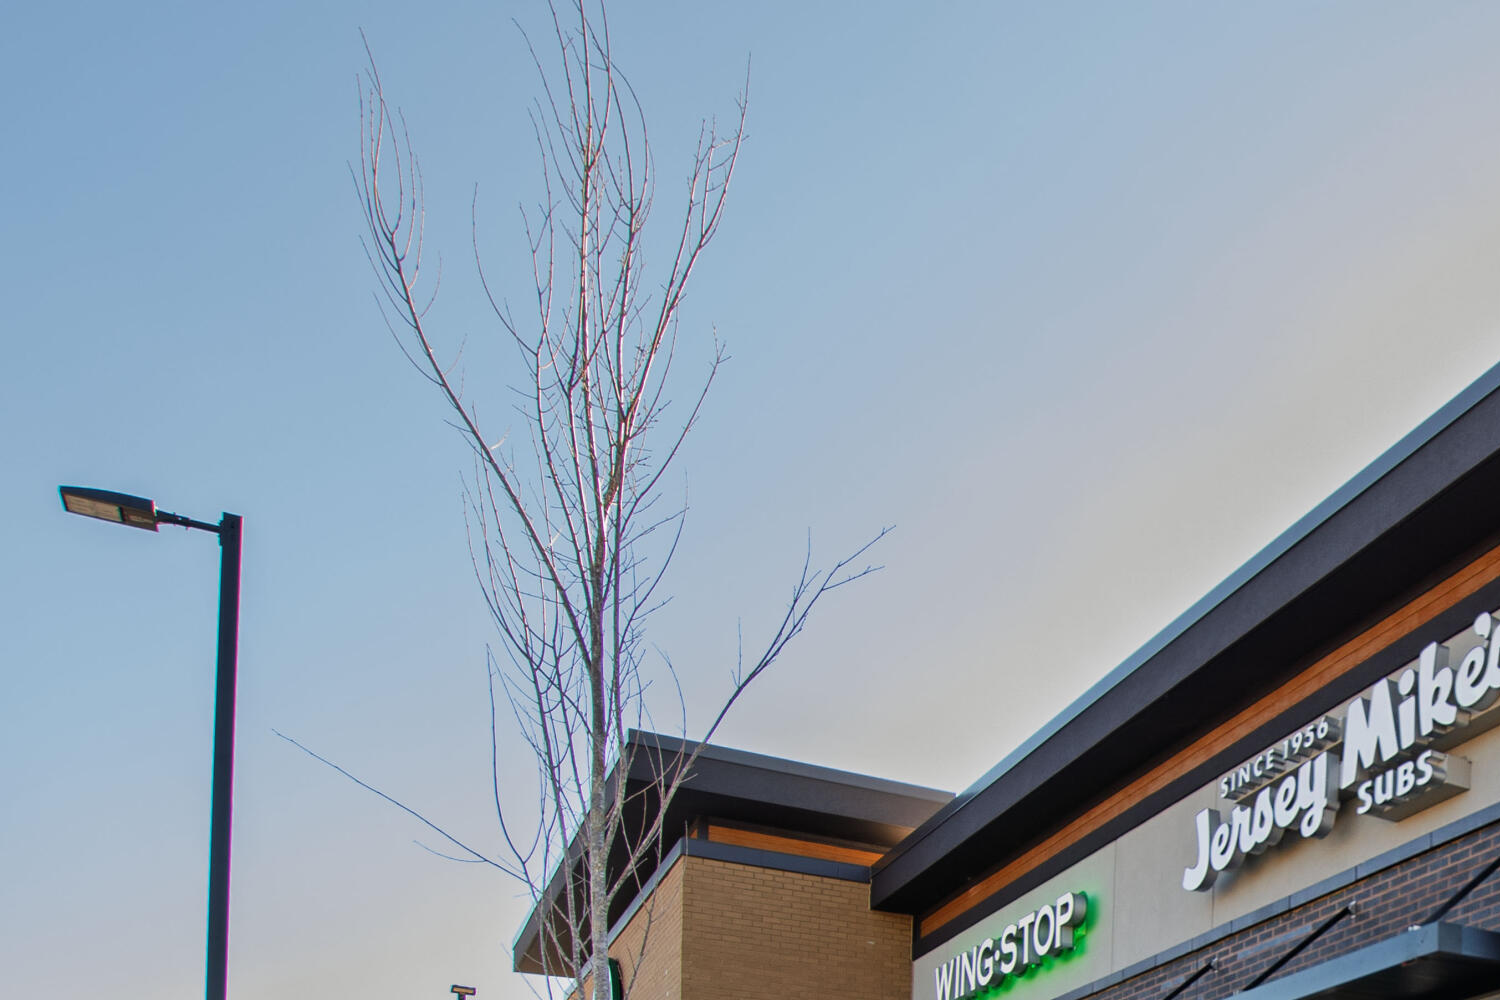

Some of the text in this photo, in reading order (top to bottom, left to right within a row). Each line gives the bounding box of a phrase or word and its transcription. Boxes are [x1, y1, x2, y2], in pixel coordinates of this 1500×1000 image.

[1219, 716, 1329, 799] SINCE 1956
[1356, 749, 1435, 815] SUBS
[1182, 751, 1329, 893] Jersey
